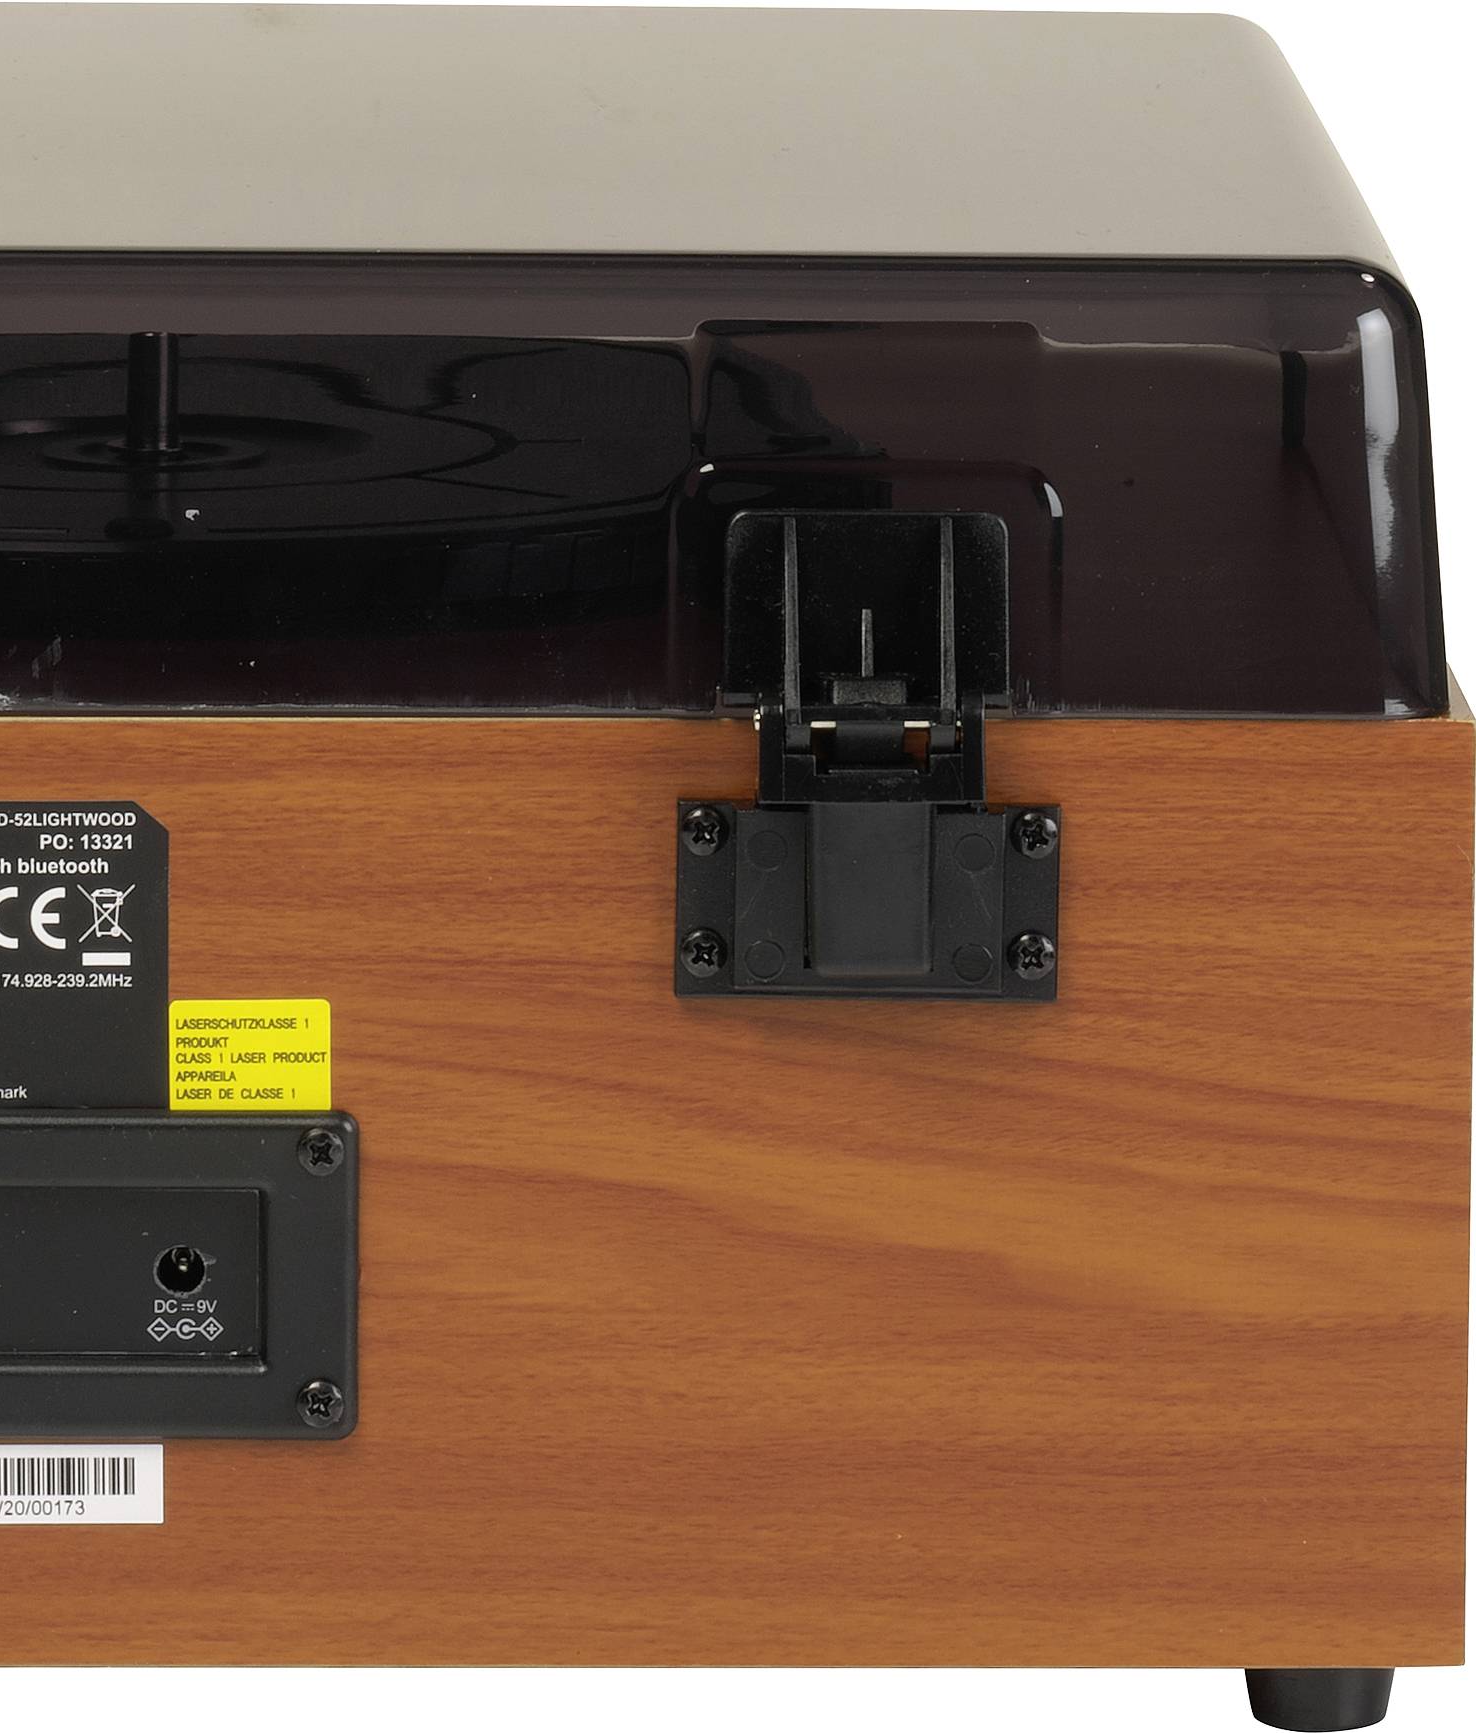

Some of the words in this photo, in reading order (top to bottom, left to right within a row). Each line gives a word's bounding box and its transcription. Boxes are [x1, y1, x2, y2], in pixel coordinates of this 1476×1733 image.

[39, 833, 74, 851] PO:
[80, 833, 133, 850] 13321
[17, 857, 109, 875] bluetooth
[175, 1017, 297, 1030] LASERSCHUTZKLASSE
[175, 1036, 229, 1049] PRODUKT
[175, 1052, 212, 1065] CLASS
[230, 1052, 266, 1064] LASER
[272, 1051, 327, 1064] PRODUCT
[176, 1088, 212, 1100] LASER
[218, 1088, 234, 1100] DE
[240, 1087, 284, 1100] CLASSE
[153, 1299, 178, 1314] DC
